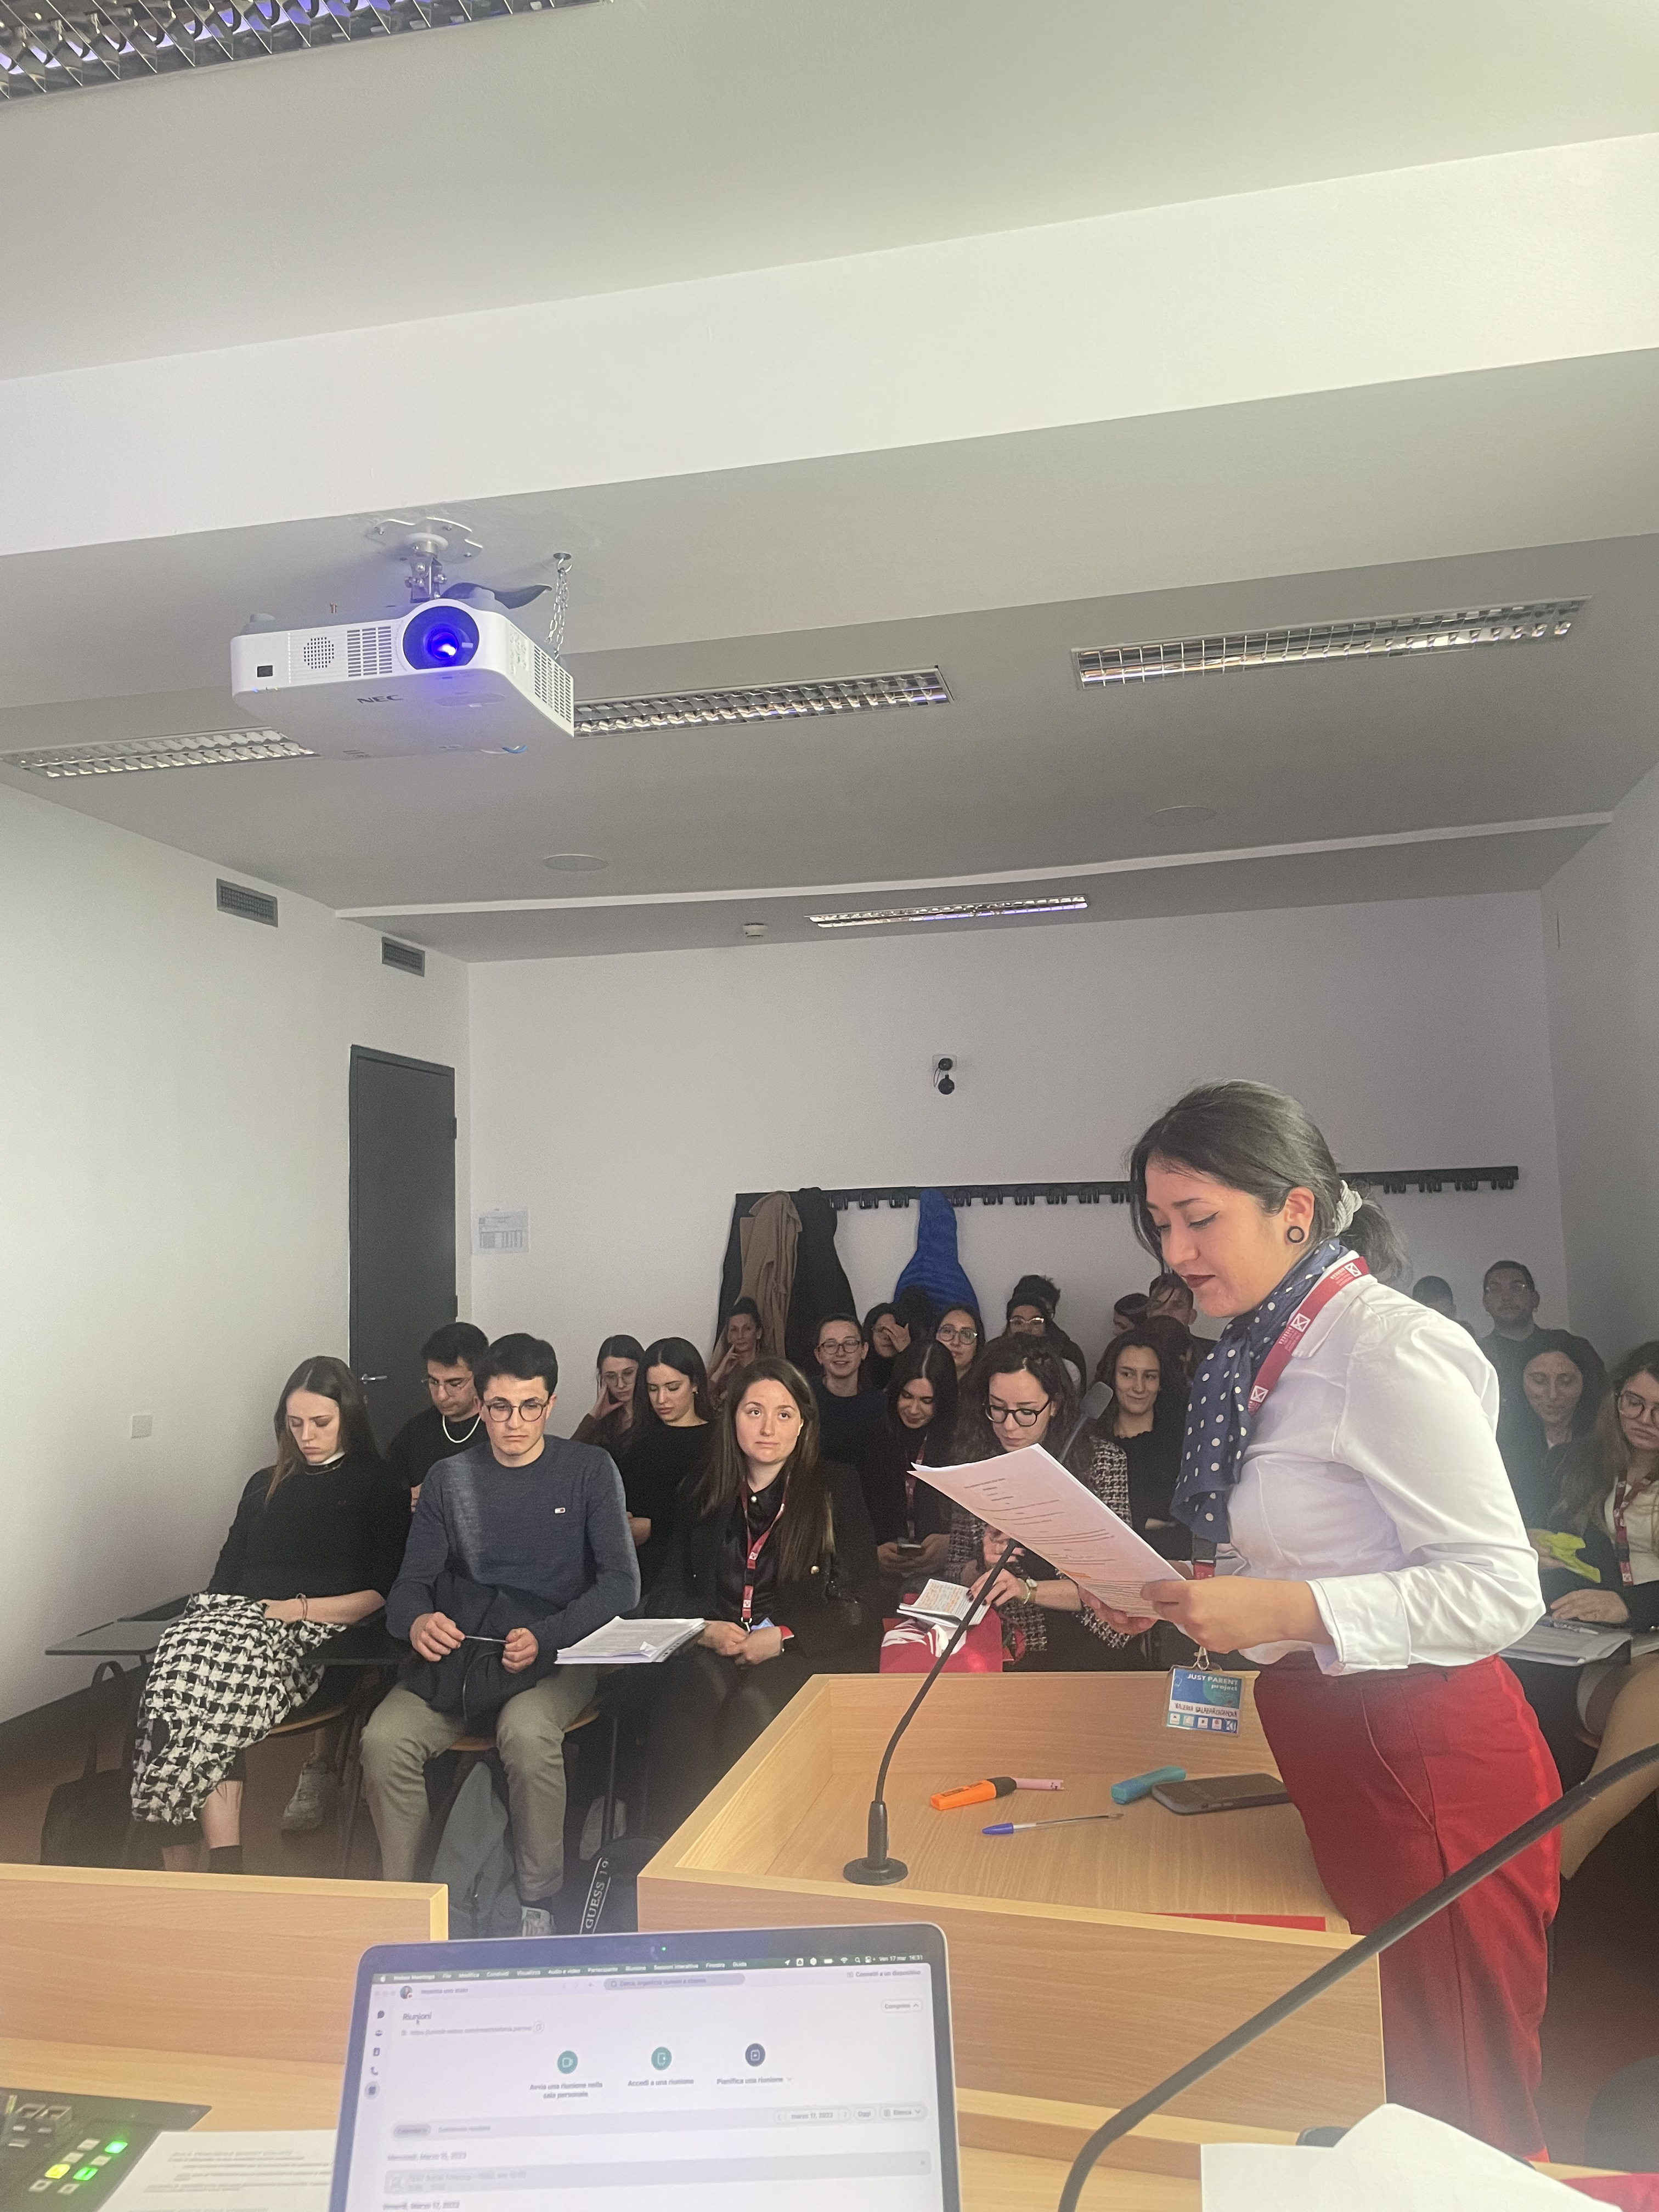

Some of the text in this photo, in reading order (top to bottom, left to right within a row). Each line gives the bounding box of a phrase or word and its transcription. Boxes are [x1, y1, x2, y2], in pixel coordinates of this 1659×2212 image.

[357, 695, 403, 704] NEC
[1207, 1675, 1238, 1685] PARENT
[585, 1882, 605, 1929] GUESS
[402, 2012, 432, 2021] Riunioni
